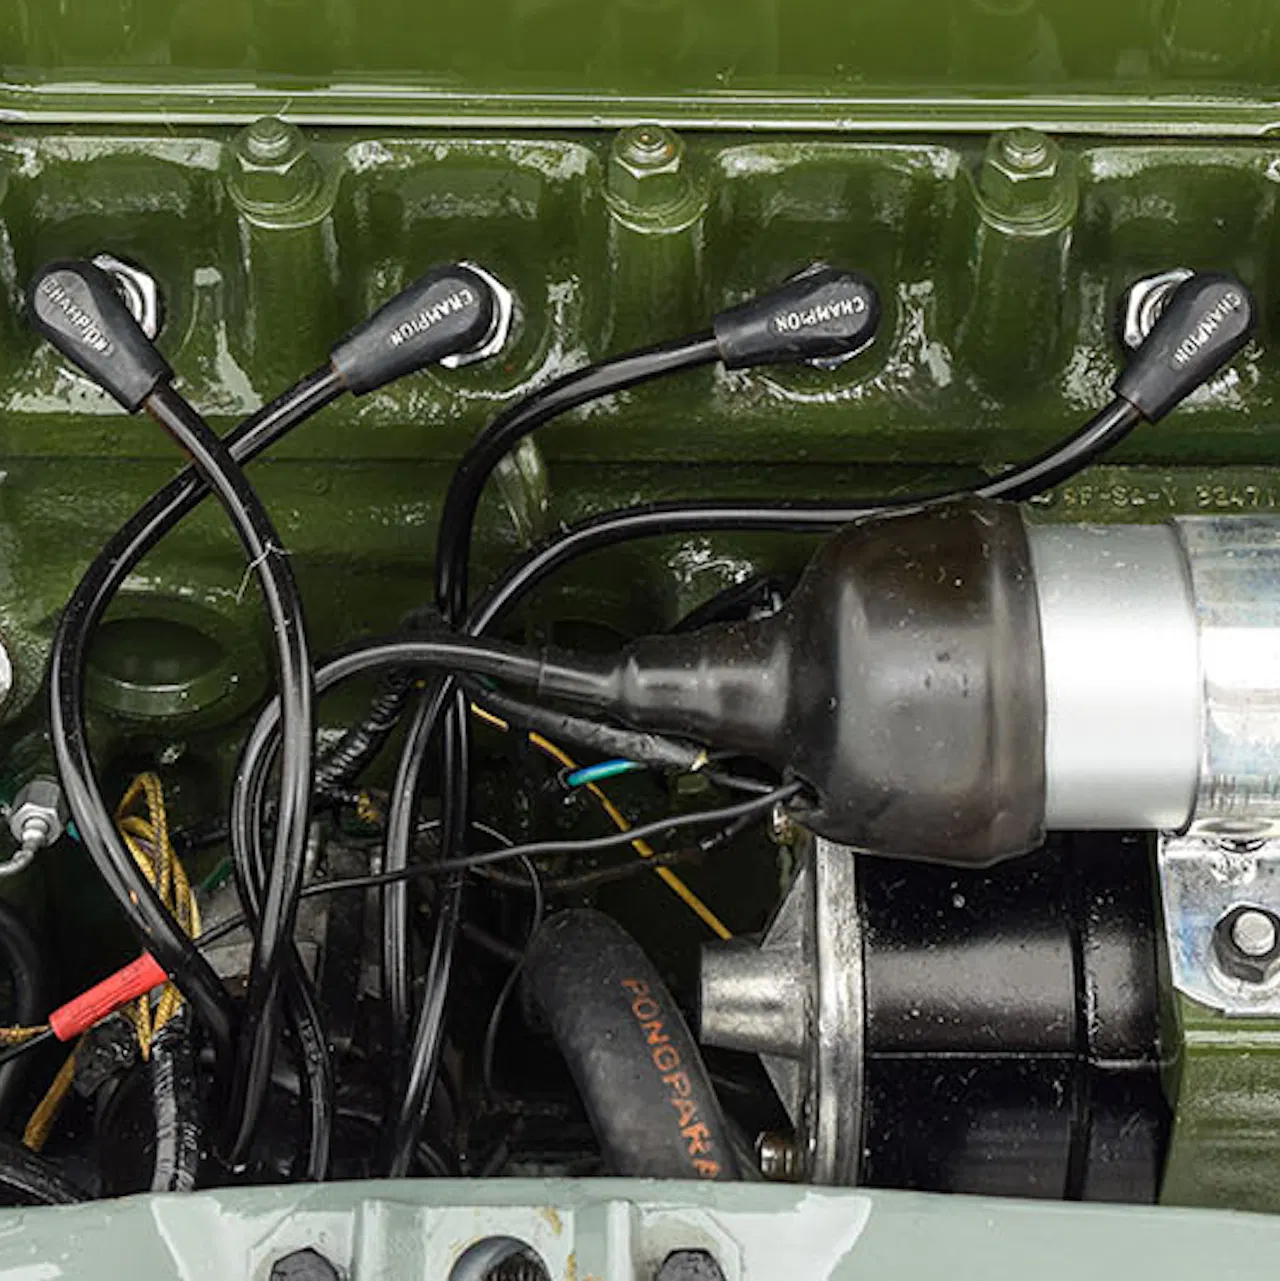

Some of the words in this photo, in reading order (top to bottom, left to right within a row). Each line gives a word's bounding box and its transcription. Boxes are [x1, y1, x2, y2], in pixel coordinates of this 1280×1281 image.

[40, 277, 111, 353] CHAMPION
[390, 289, 474, 346] CHAMPION
[775, 295, 865, 333] CHAMPION
[1174, 292, 1242, 364] CHAMPION
